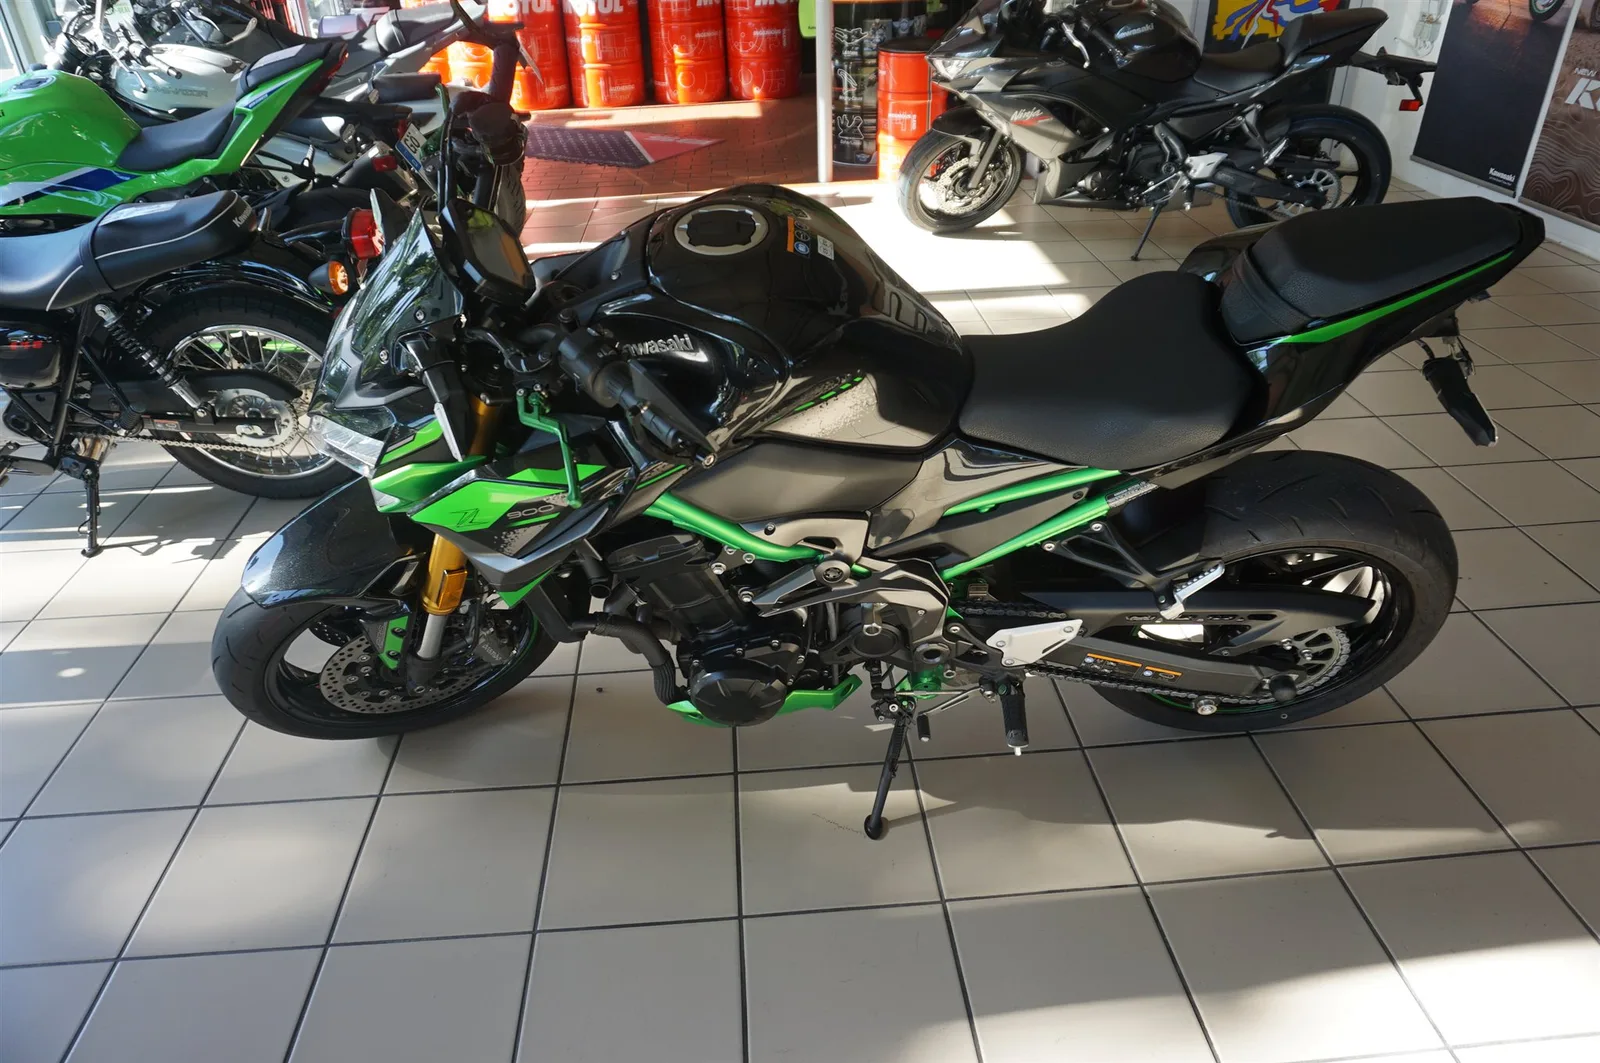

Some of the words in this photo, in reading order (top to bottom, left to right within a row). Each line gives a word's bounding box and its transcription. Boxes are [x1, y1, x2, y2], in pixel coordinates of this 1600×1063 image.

[1574, 67, 1598, 77] NEW
[1565, 77, 1600, 112] K
[1011, 107, 1043, 121] Ninja
[404, 131, 421, 154] GÖ
[1489, 167, 1516, 182] Kawasaki
[621, 333, 694, 357] awasaki
[506, 504, 555, 520] 900
